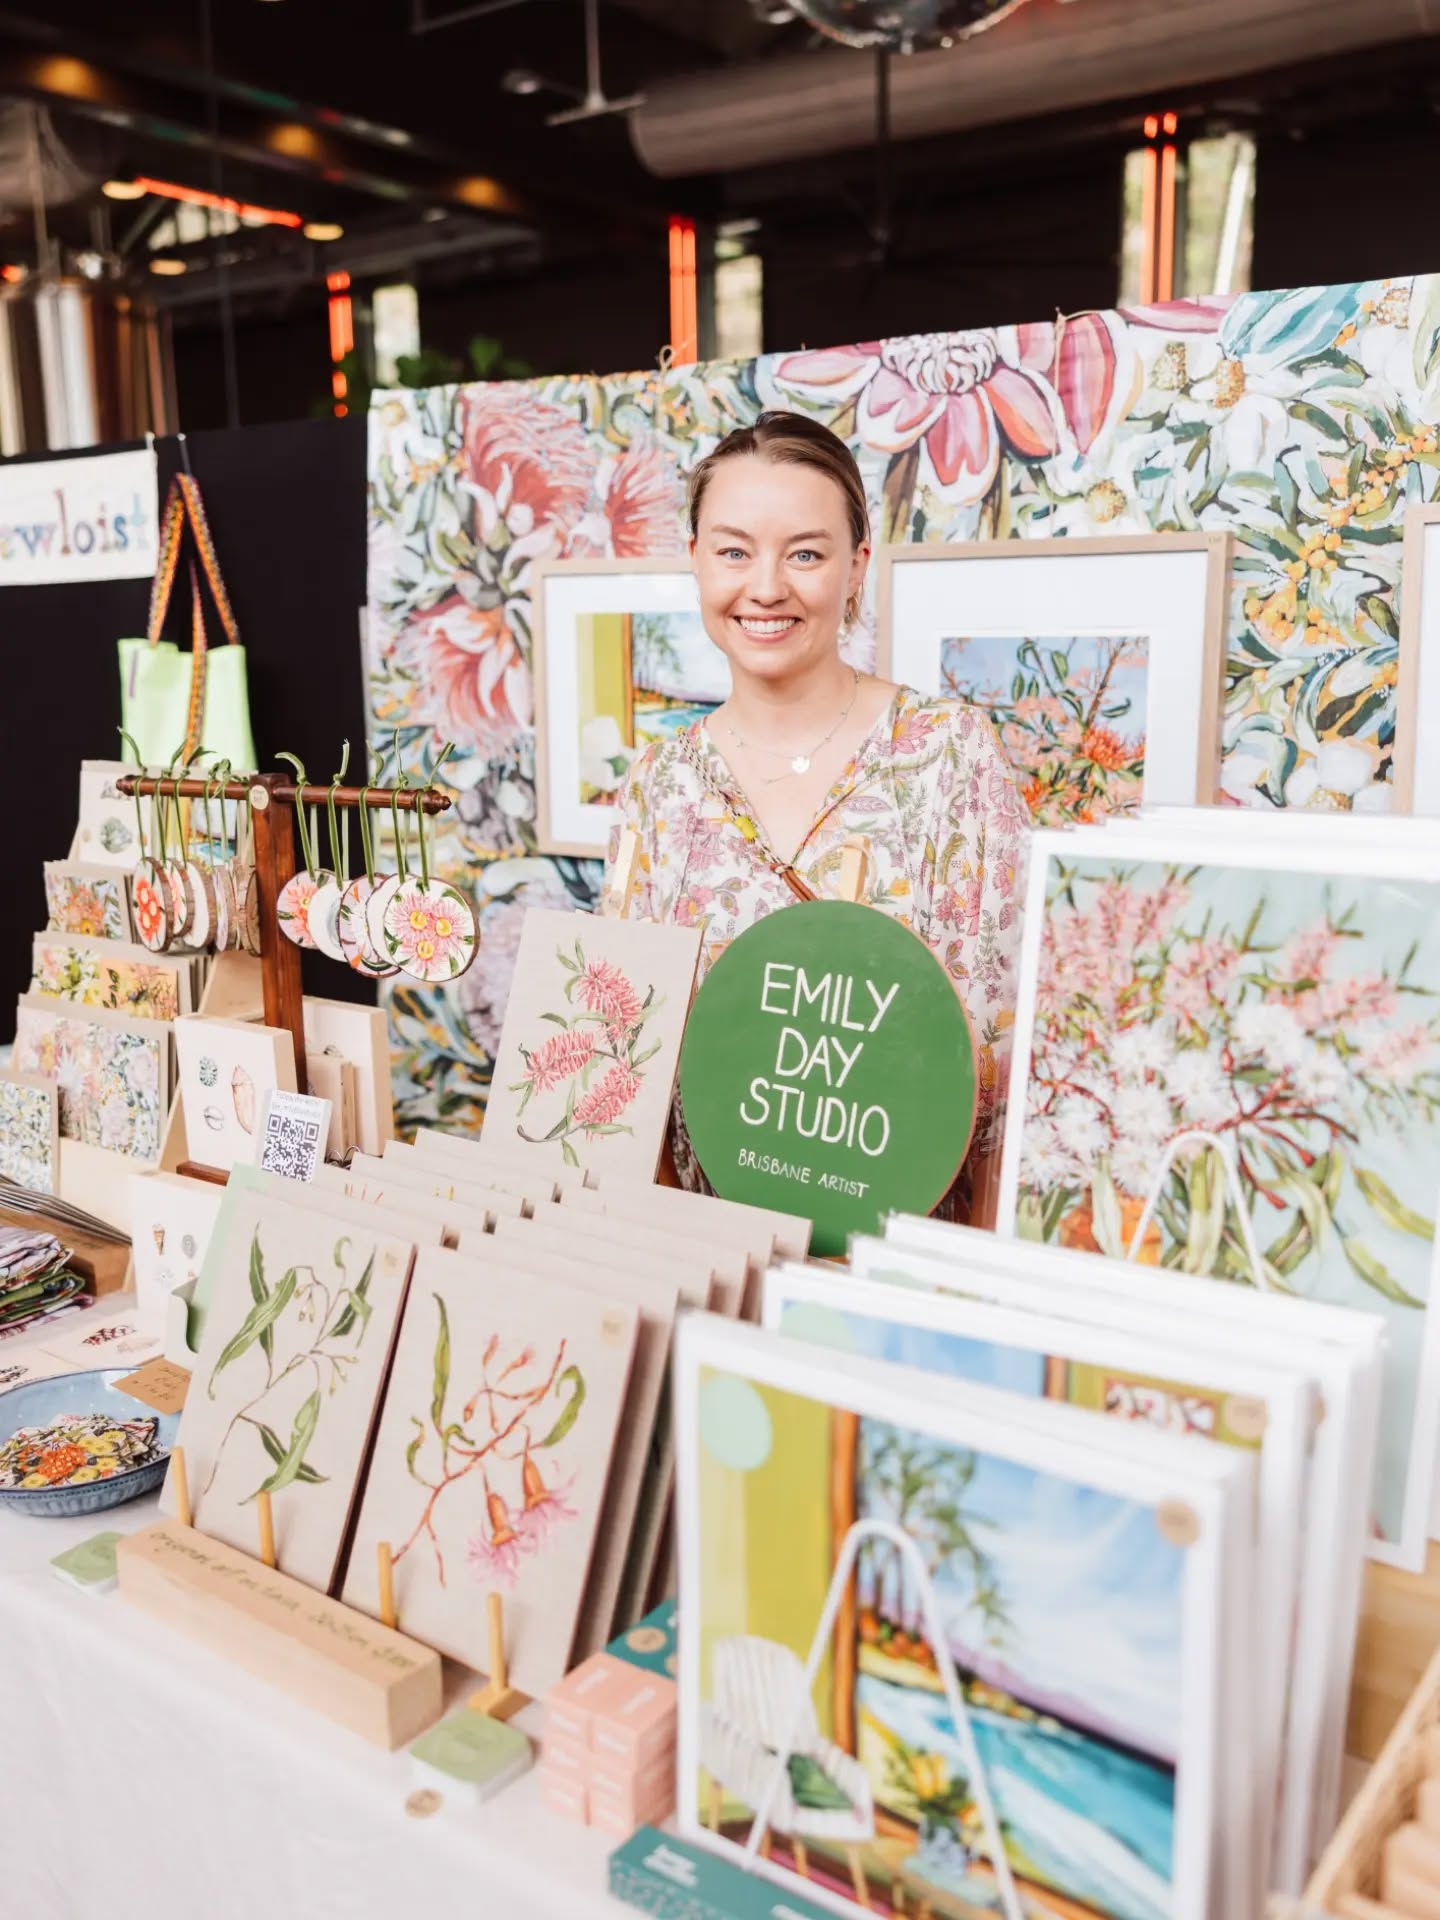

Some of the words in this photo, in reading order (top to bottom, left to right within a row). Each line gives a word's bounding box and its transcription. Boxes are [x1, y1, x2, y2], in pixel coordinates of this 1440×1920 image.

[761, 962, 900, 1032] EMILY
[775, 1027, 864, 1088] DAY
[740, 1077, 890, 1156] STUDIO
[738, 1148, 812, 1184] BRISBANE
[818, 1172, 870, 1198] ARTIST
